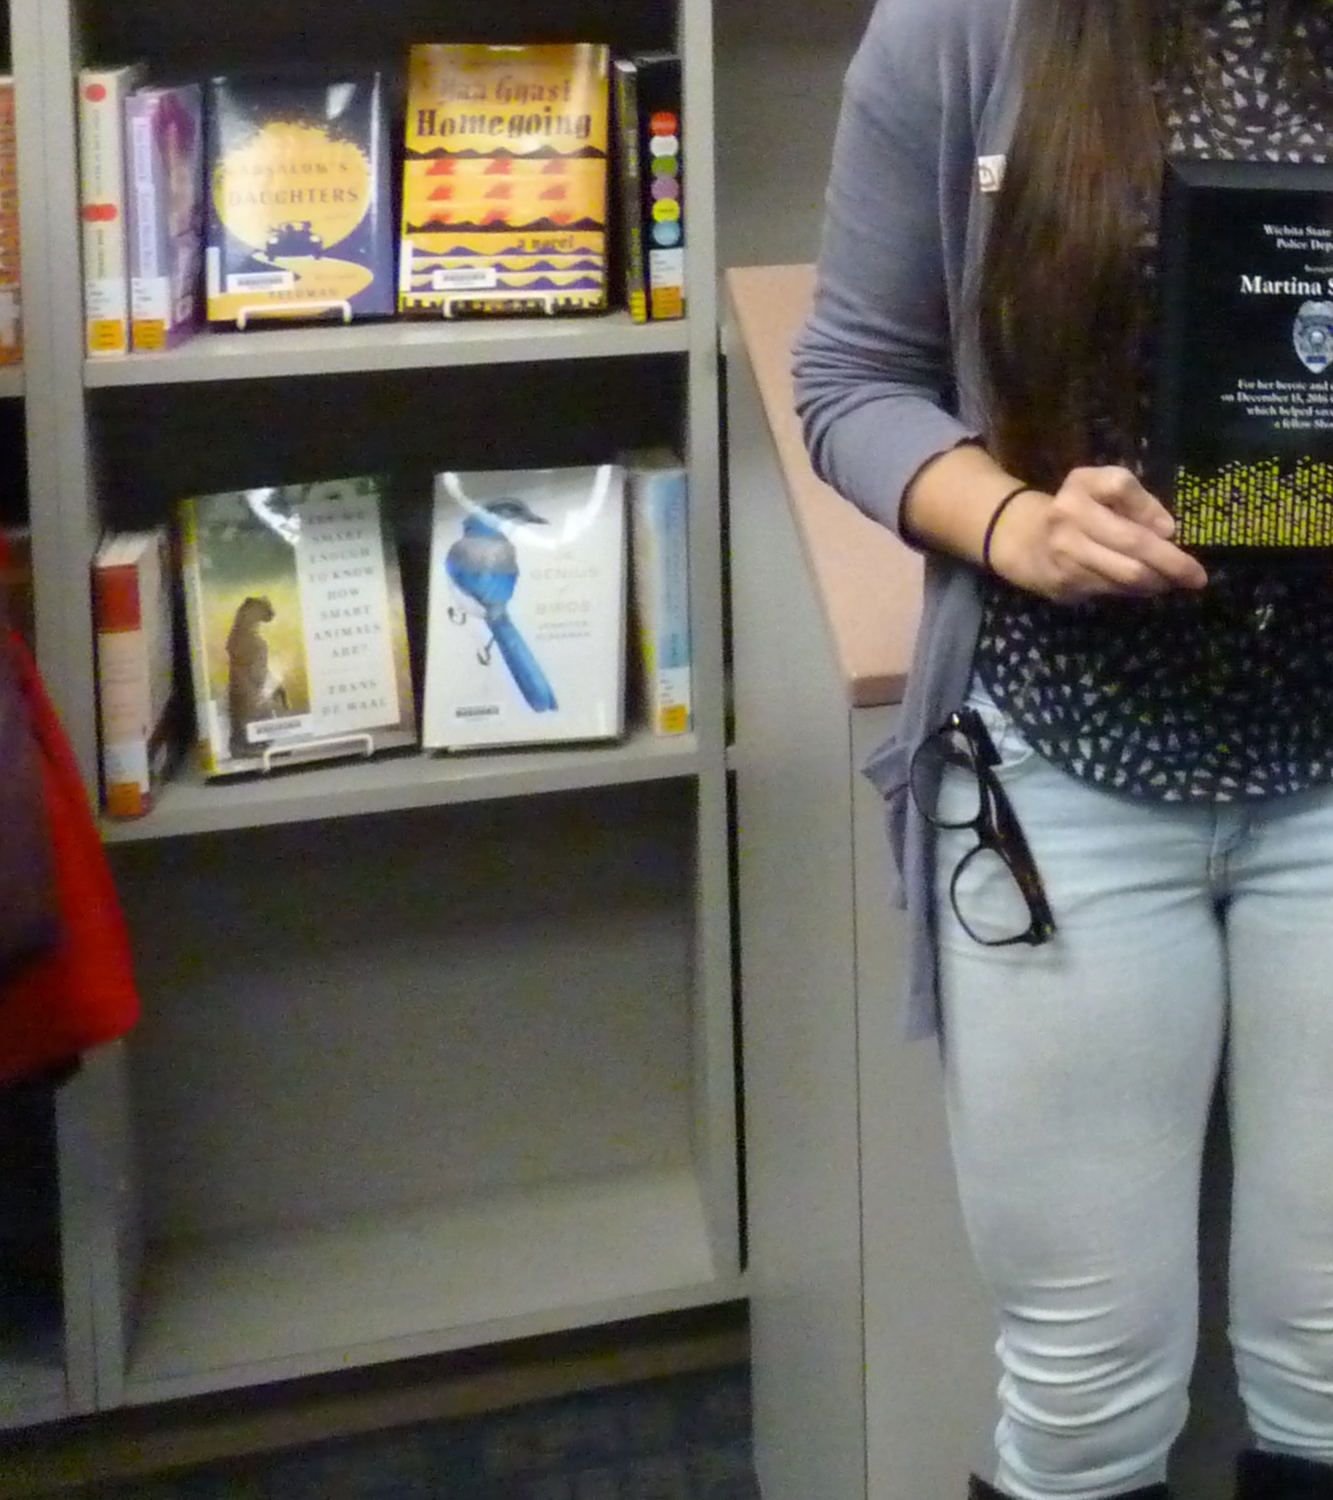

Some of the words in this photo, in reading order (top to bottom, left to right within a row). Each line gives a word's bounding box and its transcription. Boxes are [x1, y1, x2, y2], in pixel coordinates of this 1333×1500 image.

[416, 105, 592, 139] Homegoing
[228, 187, 359, 206] DAUGHTERS
[1263, 224, 1304, 236] Wichita
[1306, 226, 1331, 237] State
[1276, 238, 1308, 250] Police
[1240, 275, 1322, 296] Martina
[1237, 379, 1255, 389] For
[1257, 380, 1275, 389] her
[1276, 380, 1306, 391] heroic
[1309, 381, 1329, 390] and
[1237, 392, 1289, 402] December
[1246, 405, 1277, 416] which
[1279, 406, 1313, 418] helped
[310, 548, 371, 565] ENOUGH
[309, 573, 328, 584] TO
[332, 567, 374, 580] KNOW
[327, 589, 360, 601] HOW
[320, 605, 371, 621] SMART
[313, 623, 381, 641] ANIMALS
